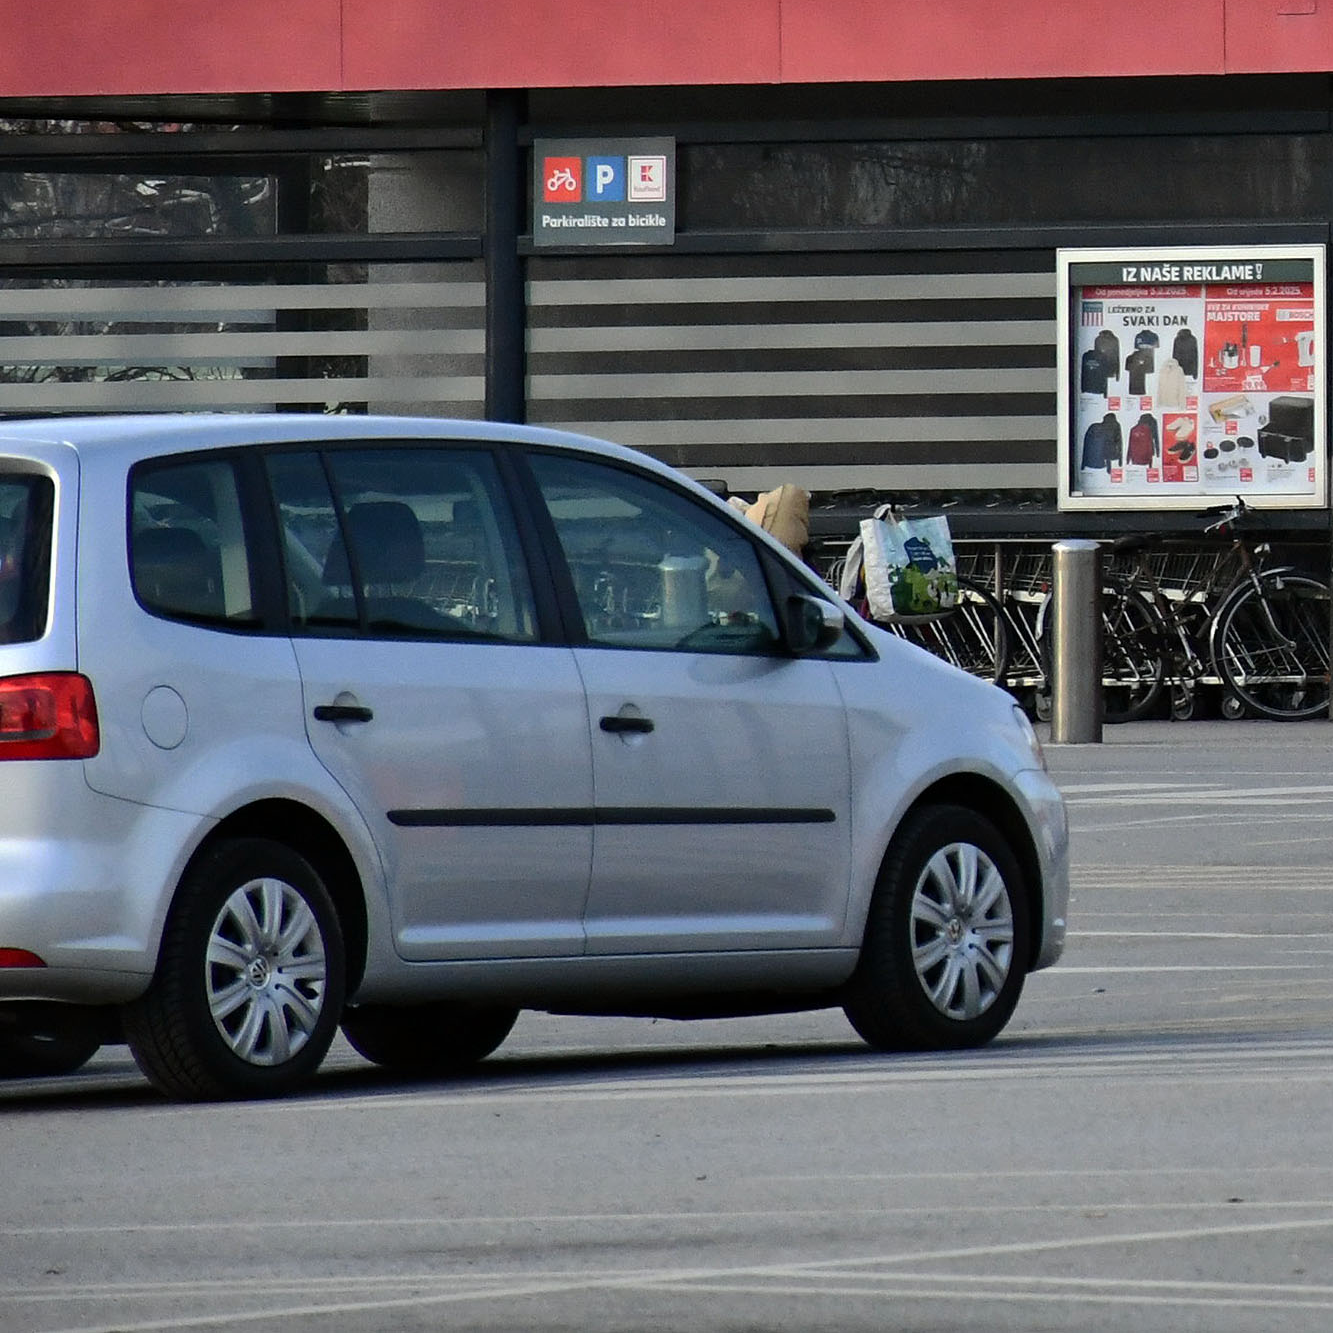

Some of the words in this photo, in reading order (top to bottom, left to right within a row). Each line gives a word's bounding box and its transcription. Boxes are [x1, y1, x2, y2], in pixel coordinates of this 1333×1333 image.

[596, 164, 614, 194] P
[542, 215, 609, 228] Parkiralište
[611, 219, 626, 227] za
[628, 214, 667, 227] bicikle
[1122, 268, 1137, 282] IZ
[1141, 263, 1180, 282] NAŠE
[1107, 305, 1143, 314] LEŽERNO
[1145, 306, 1156, 314] ZA
[1122, 315, 1160, 327] SVAKI
[1163, 315, 1189, 327] DAN
[1206, 311, 1261, 322] MAJSTORE
